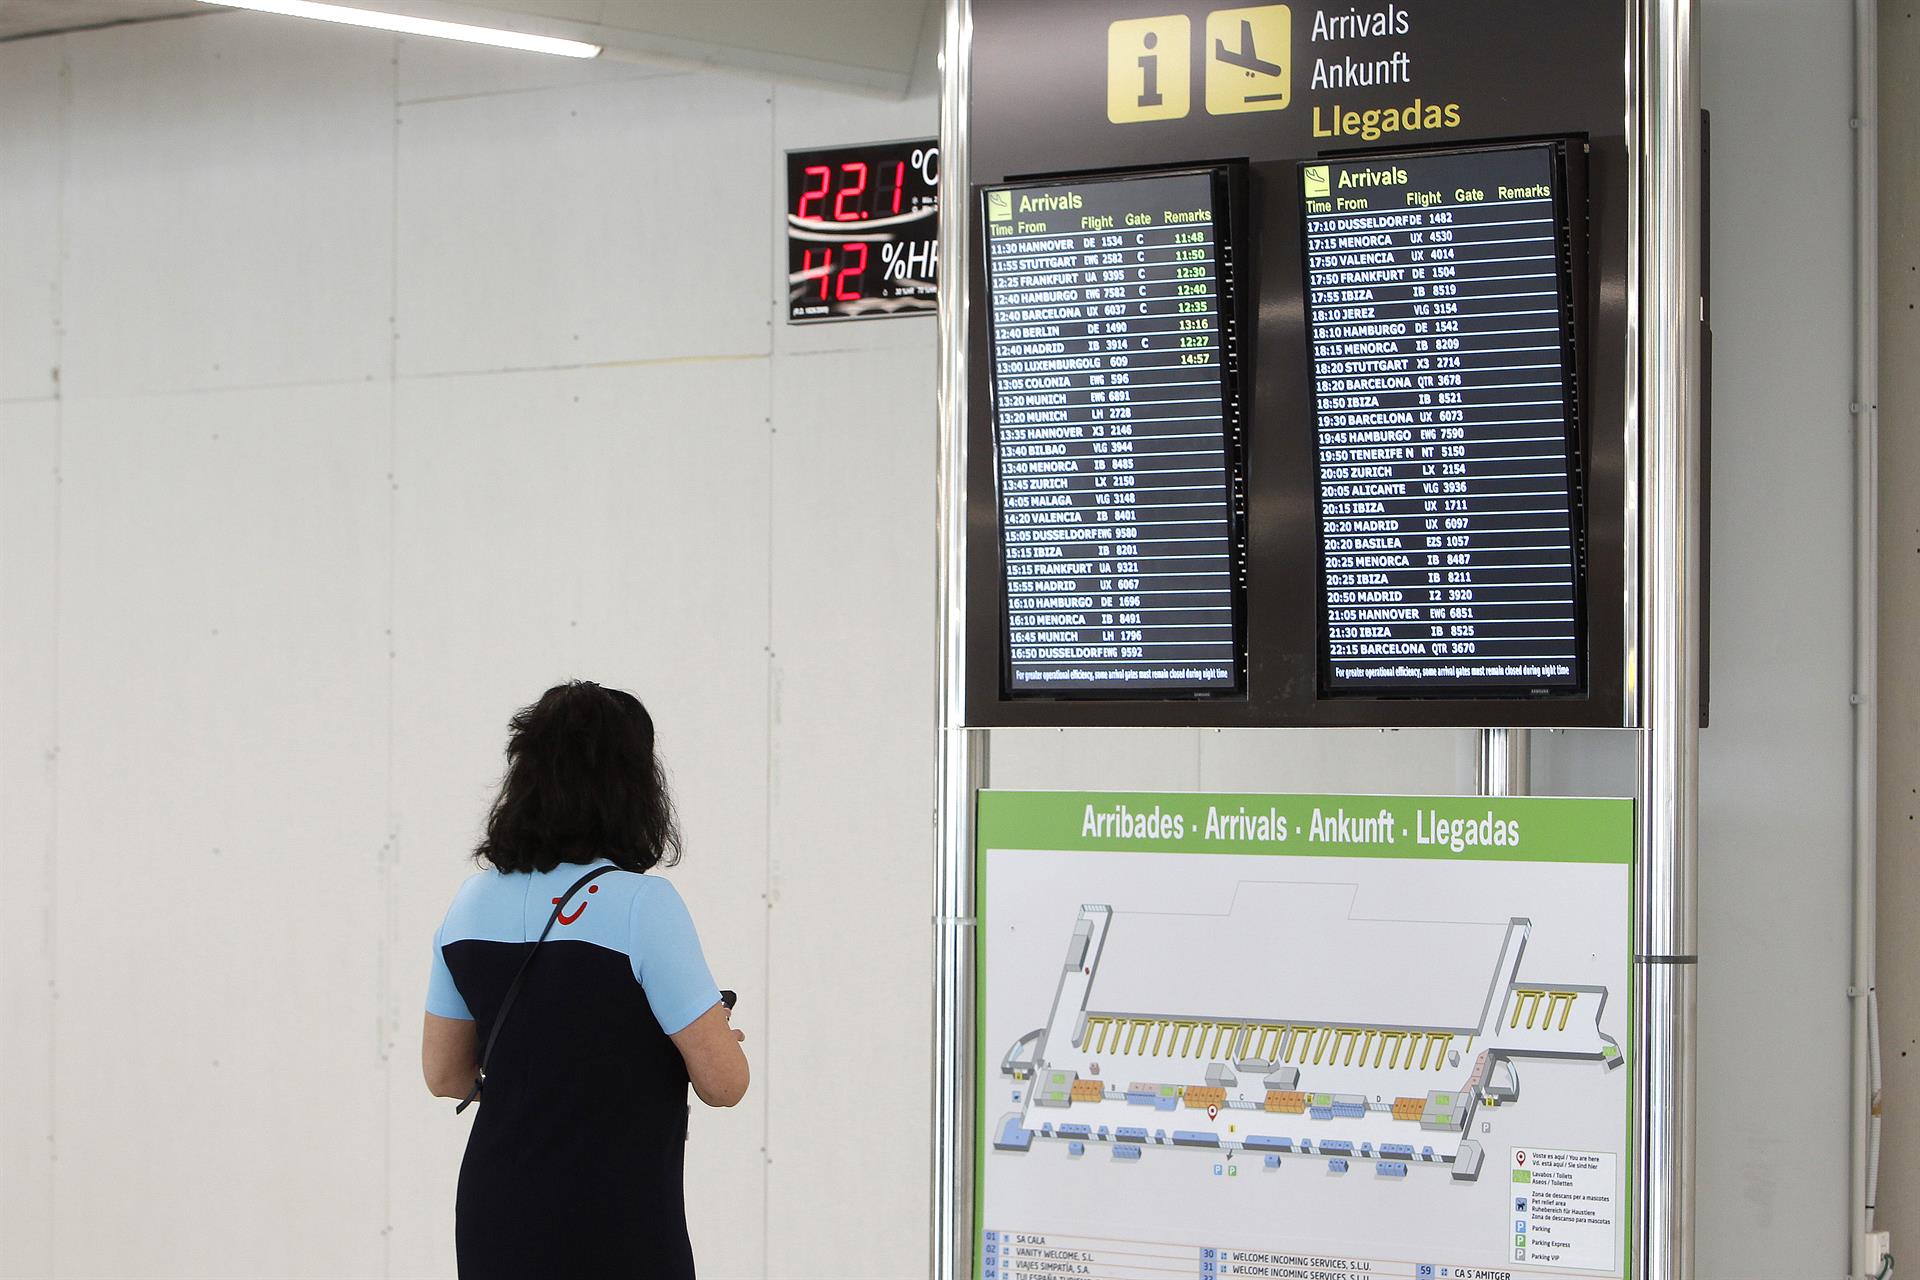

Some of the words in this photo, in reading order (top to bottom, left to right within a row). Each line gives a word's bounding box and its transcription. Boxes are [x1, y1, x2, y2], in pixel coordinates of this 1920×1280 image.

[1311, 4, 1409, 41] Arrivals
[1311, 52, 1410, 90] Ankunft
[1312, 98, 1461, 141] Llegadas
[1338, 166, 1408, 188] Arrivals
[797, 161, 904, 222] 22.1
[1020, 192, 1082, 213] Arrivals
[1306, 200, 1331, 213] Time
[1337, 197, 1368, 210] From
[1407, 191, 1441, 208] Flight
[1455, 188, 1484, 202] Gate
[1498, 184, 1550, 199] Remarks
[991, 224, 1013, 236] Time
[1018, 221, 1046, 233] From
[1081, 215, 1113, 231] Flight
[1125, 213, 1152, 226] Gate
[1164, 209, 1211, 223] Remarks
[1307, 220, 1336, 232] 17:10
[1337, 215, 1408, 230] DUSSELDORF
[1409, 214, 1422, 225] DE
[1429, 212, 1452, 224] 1482
[991, 240, 1017, 255] 11:30
[1018, 239, 1074, 253] HANNOVER
[1083, 237, 1095, 248] DE
[1101, 235, 1123, 247] 1534
[1136, 233, 1144, 244] C
[1175, 231, 1204, 243] 11:48
[991, 258, 1018, 272] 11:55
[1018, 255, 1077, 270] STUTTGART
[1102, 252, 1123, 264] 2582
[1137, 251, 1144, 262] C
[1175, 249, 1204, 260] 11:50
[803, 243, 868, 301] 42
[992, 275, 1019, 289] 12:25
[1019, 272, 1079, 287] FRANKFURT
[1084, 271, 1097, 282] UA
[1102, 269, 1124, 281] 9395
[1137, 268, 1145, 279] C
[1176, 266, 1205, 278] 12:30
[993, 292, 1020, 306] 12:40
[1020, 289, 1078, 304] HAMBURGO
[1103, 286, 1125, 298] 7582
[1138, 285, 1146, 296] C
[1177, 284, 1206, 295] 12:40
[994, 309, 1021, 323] 12:40
[1021, 307, 1081, 320] BARCELONA
[1086, 305, 1098, 317] UX
[1104, 304, 1126, 315] 6037
[1139, 302, 1147, 313] C
[1178, 301, 1207, 312] 12:35
[995, 327, 1021, 340] 12:40
[1022, 325, 1059, 338] BERLIN
[1087, 323, 1099, 334] DE
[1105, 321, 1127, 333] 1490
[1179, 318, 1208, 330] 13:16
[1313, 327, 1341, 338] 18:10
[1343, 323, 1406, 337] HAMBURGO
[1415, 322, 1428, 333] DE
[1435, 320, 1458, 332] 1542
[996, 344, 1022, 356] 12:40
[1023, 342, 1064, 355] MADRID
[1088, 340, 1100, 351] IB
[1106, 338, 1128, 350] 3914
[1141, 337, 1148, 348] C
[1180, 336, 1208, 347] 12:27
[1319, 432, 1347, 444] 19:45
[1348, 429, 1411, 442] HAMBURGO
[1420, 428, 1436, 439] EWG
[1440, 427, 1464, 439] 7590
[1323, 521, 1352, 532] 20:20
[1353, 520, 1398, 531] MADRID
[1425, 519, 1438, 529] UX
[1445, 518, 1468, 529] 6097
[1330, 644, 1358, 655] 22:15
[1360, 643, 1425, 654] BARCELONA
[1431, 643, 1447, 655] QTR
[1451, 642, 1475, 653] 3670
[1082, 804, 1183, 839] Arribades
[1204, 806, 1287, 842] Arrivals
[1309, 807, 1393, 844] Ankunft
[1415, 810, 1519, 853] Llegadas
[986, 1231, 996, 1241] 01
[1016, 1234, 1026, 1243] SA
[1027, 1235, 1046, 1244] CALA
[1532, 1225, 1550, 1233] Parking
[1016, 1247, 1042, 1257] VANITY
[1203, 1249, 1214, 1259] 30
[1233, 1252, 1268, 1263] WELCOME
[1270, 1255, 1308, 1266] INCOMING
[1203, 1262, 1213, 1271] 31
[1232, 1265, 1268, 1276] WELCOME
[1270, 1268, 1308, 1279] INCOMING
[1420, 1265, 1431, 1275] 59
[1454, 1268, 1465, 1278] CA
